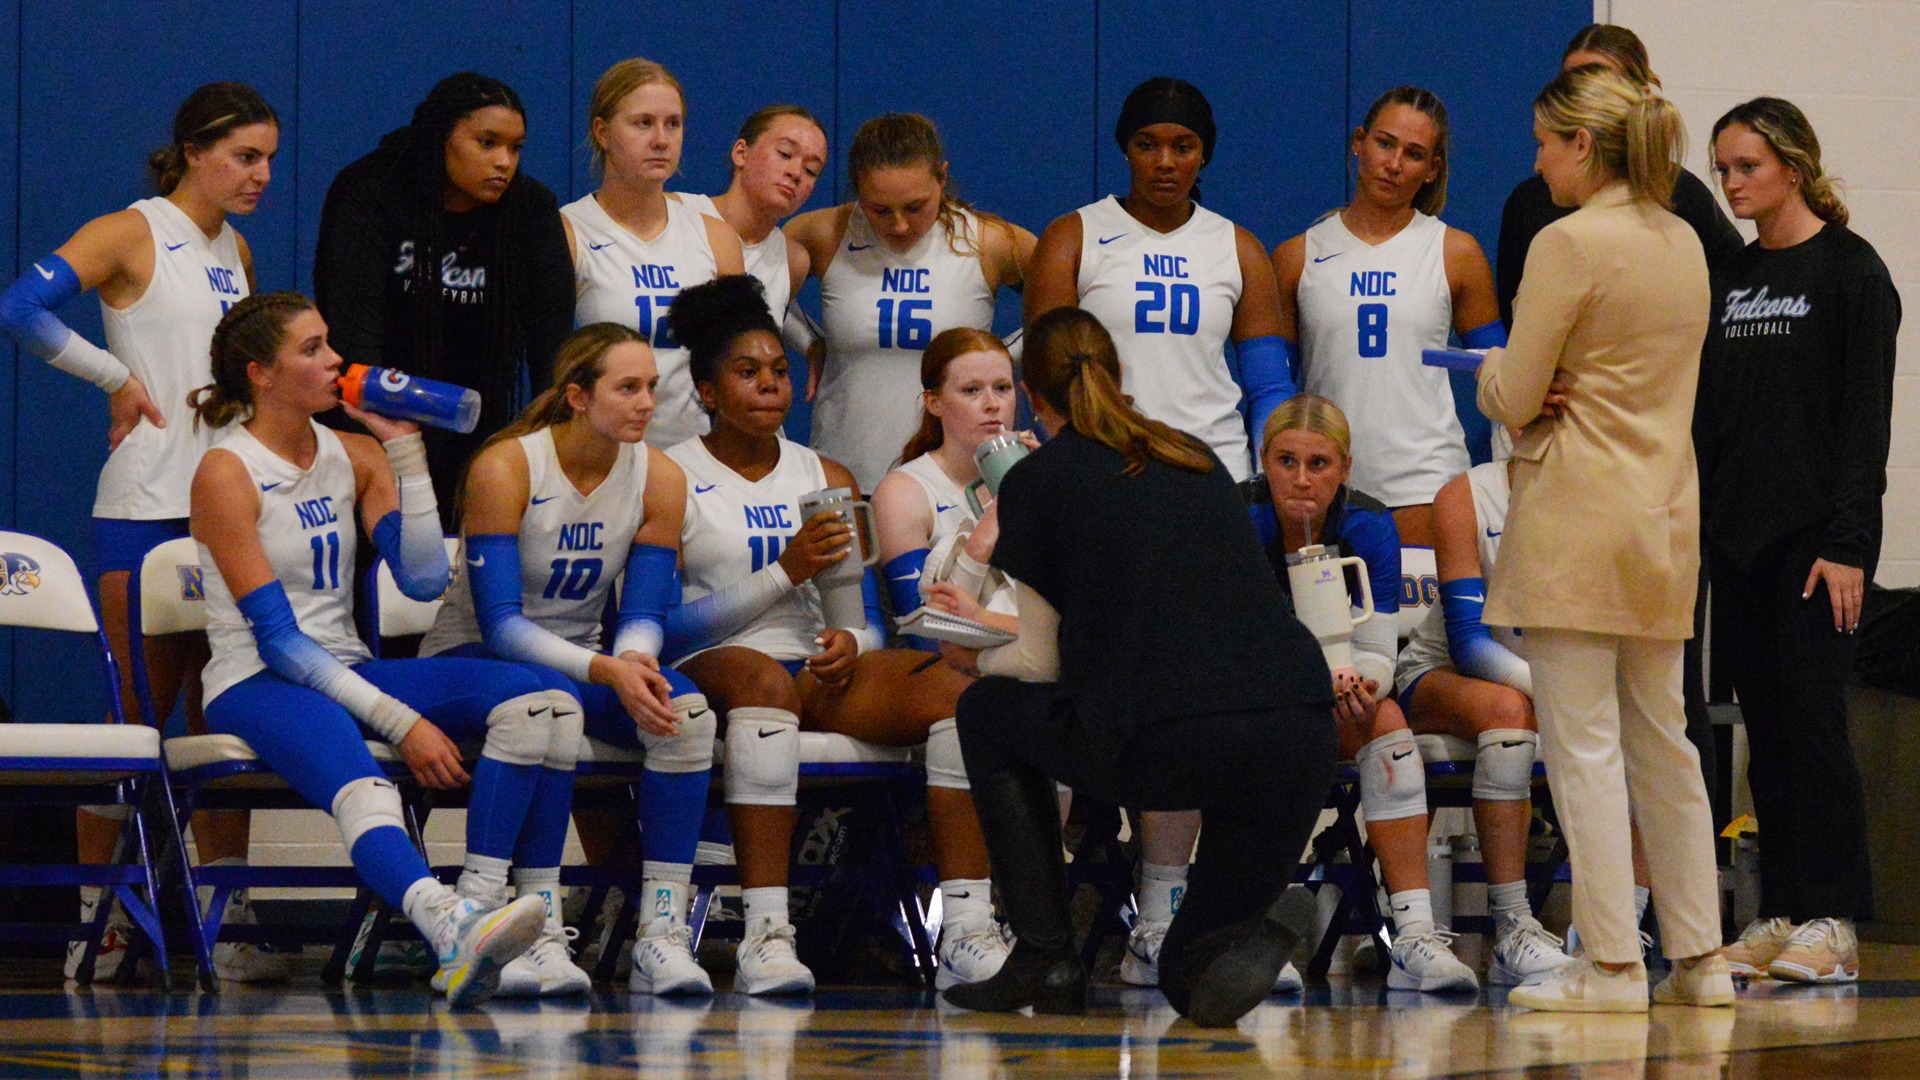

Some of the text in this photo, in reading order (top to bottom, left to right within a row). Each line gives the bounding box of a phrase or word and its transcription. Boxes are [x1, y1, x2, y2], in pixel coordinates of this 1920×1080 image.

[204, 266, 240, 295] NDC
[631, 263, 680, 289] NDC
[881, 267, 930, 293] NDC
[1143, 253, 1189, 279] NDC
[1349, 270, 1397, 297] NDC
[1134, 281, 1201, 336] 20
[1721, 285, 1811, 325] Falcons
[876, 298, 933, 351] 16
[1357, 303, 1389, 358] 8
[1725, 321, 1791, 339] VOLLEYBALL
[294, 496, 338, 530] NDC
[743, 504, 793, 529] NDC
[557, 522, 604, 551] NDC
[310, 530, 340, 590] 11
[542, 557, 604, 601] 10
